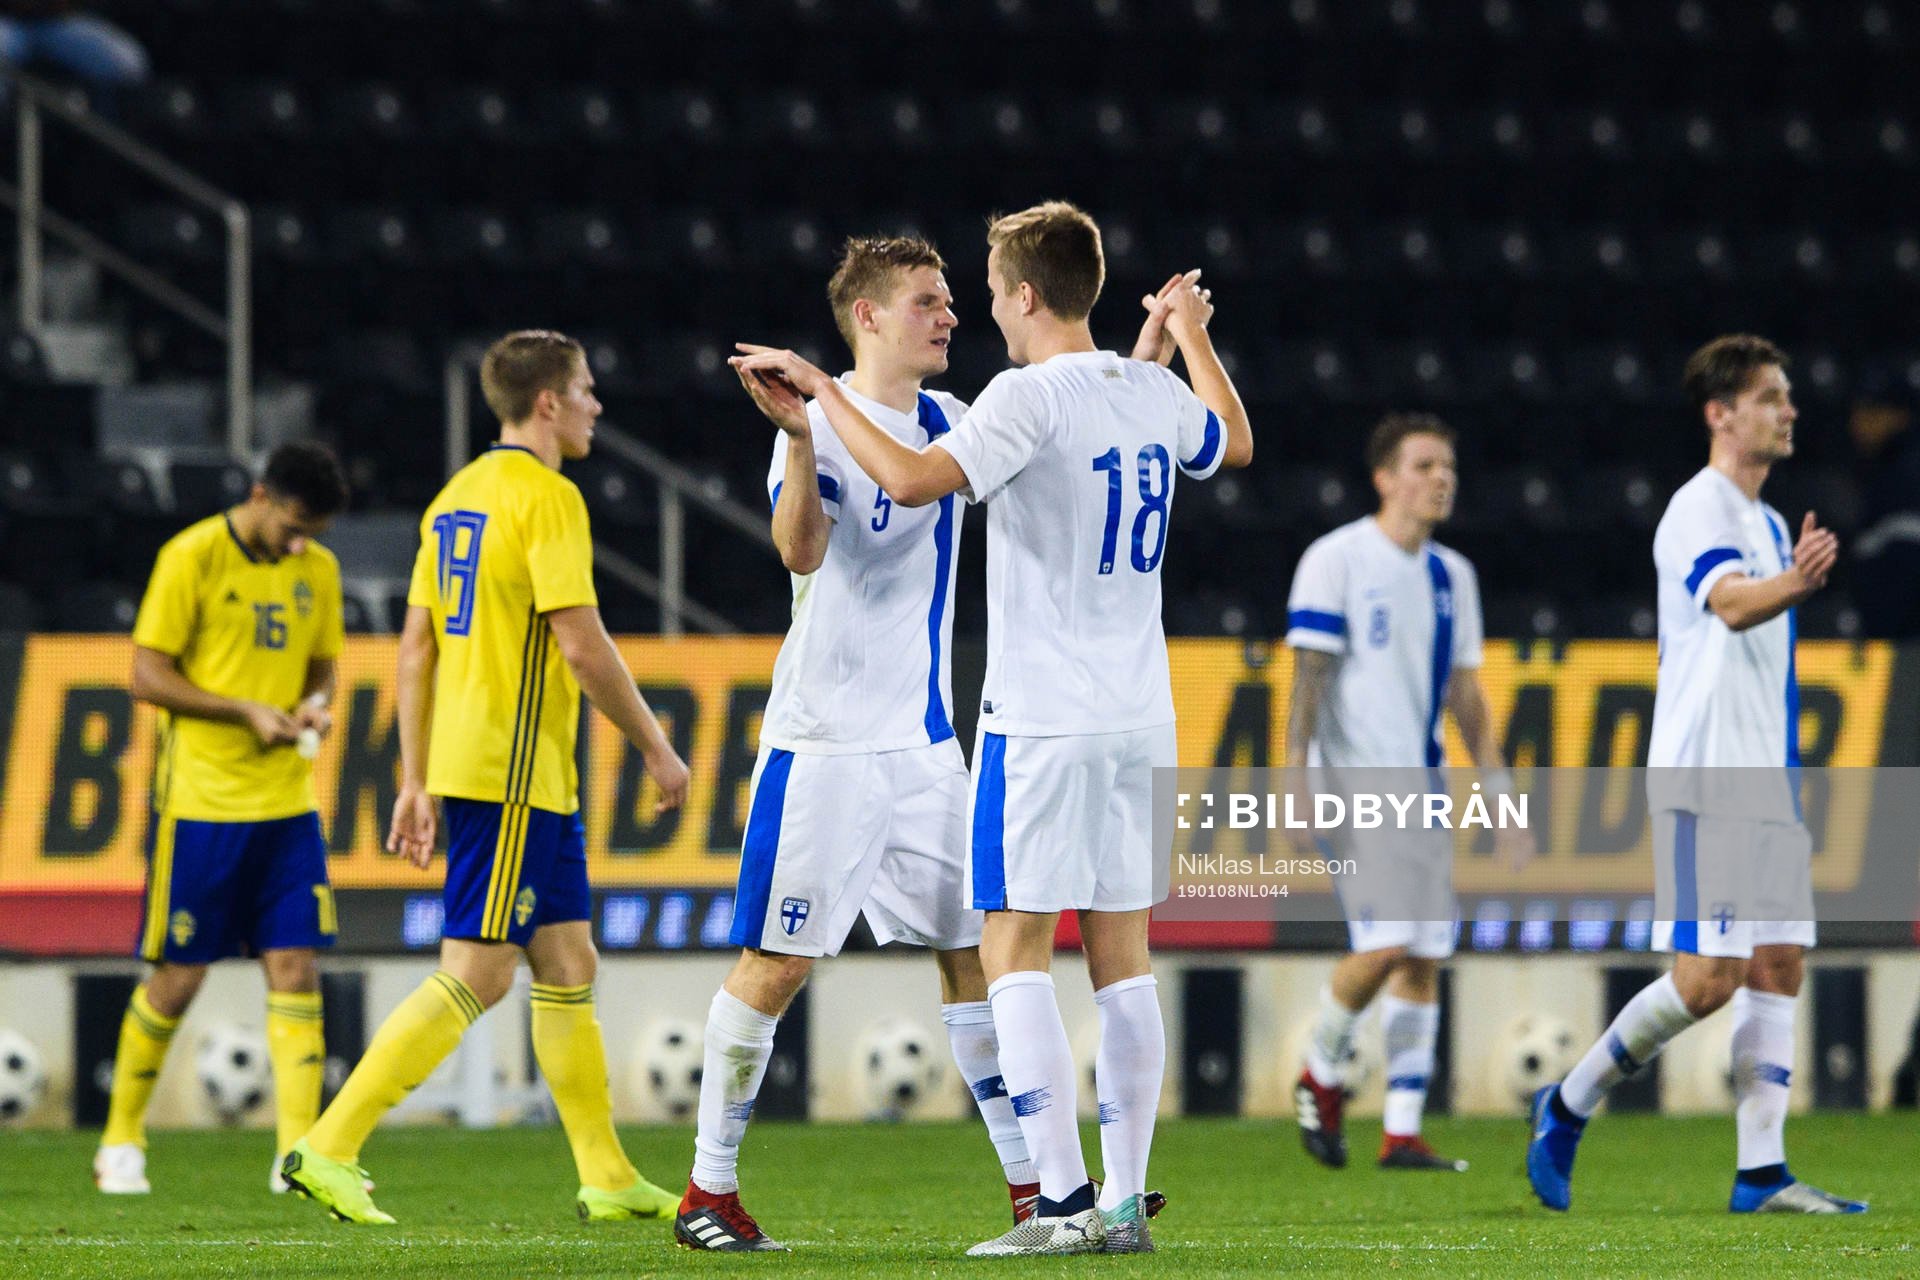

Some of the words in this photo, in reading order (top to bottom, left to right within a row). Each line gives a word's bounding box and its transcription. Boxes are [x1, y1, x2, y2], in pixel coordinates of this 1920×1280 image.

[871, 486, 891, 532] 5
[1092, 443, 1171, 575] 18
[432, 509, 488, 637] 19
[253, 602, 287, 650] 16
